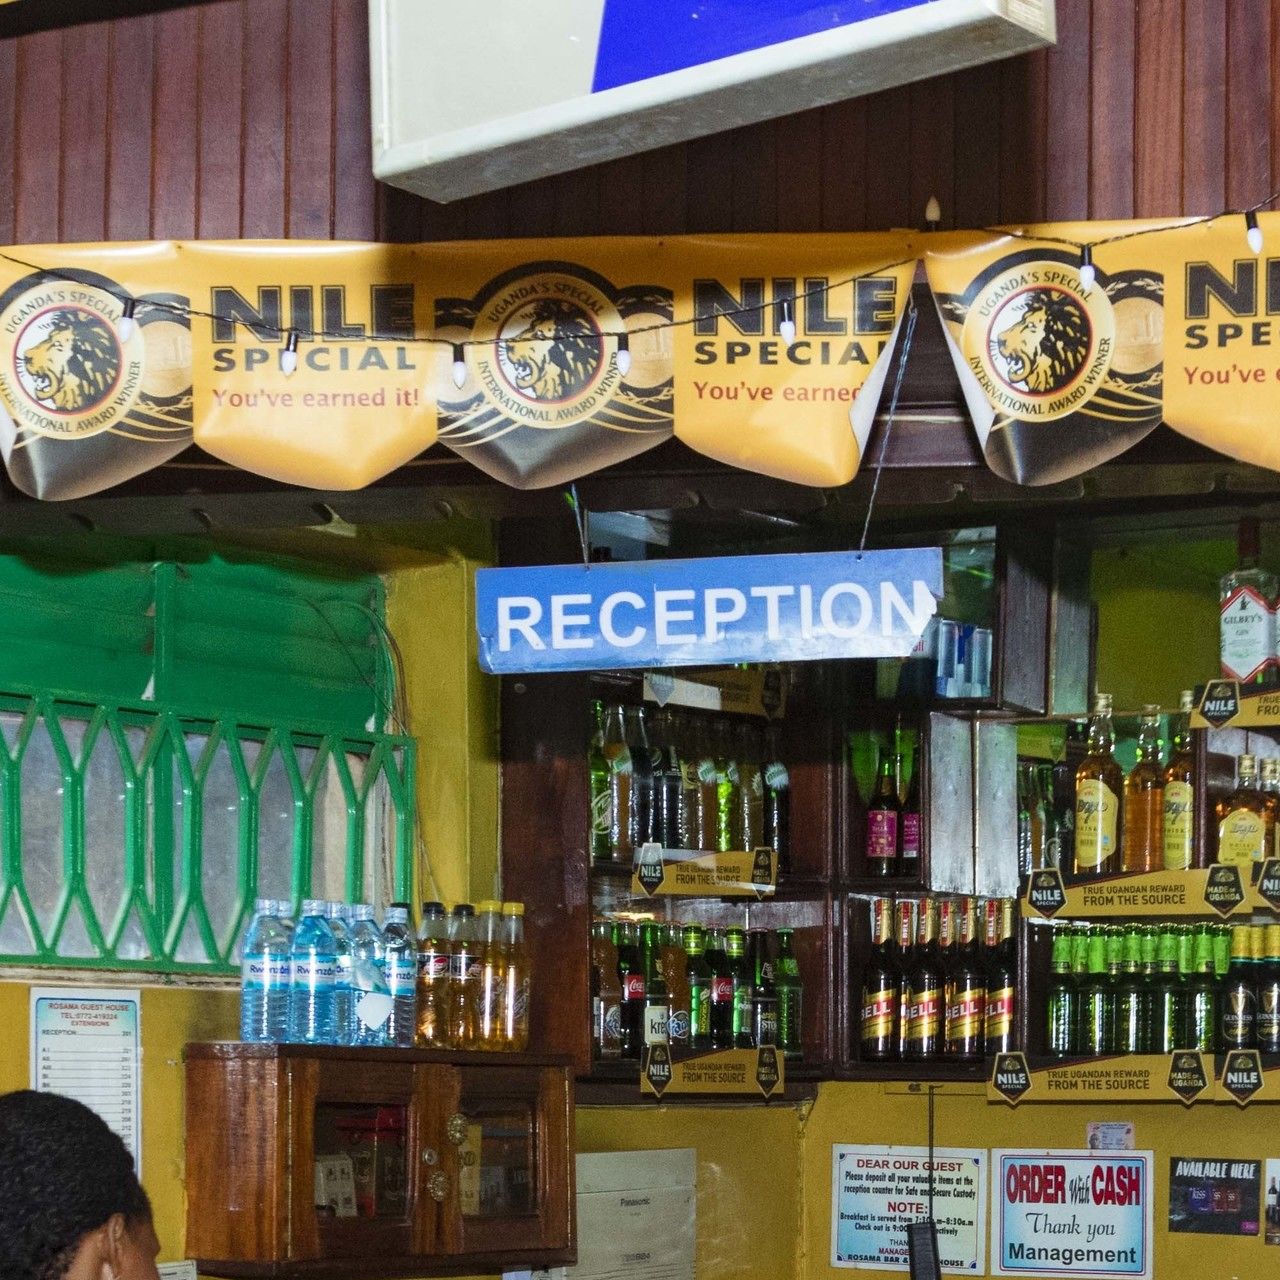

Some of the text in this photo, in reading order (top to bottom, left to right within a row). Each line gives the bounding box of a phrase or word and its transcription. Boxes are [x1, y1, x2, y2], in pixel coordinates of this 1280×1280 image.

[488, 280, 605, 323] UGANDA'S SPECIAL
[978, 270, 1095, 320] UGANDA'S SPECIAL
[4, 289, 124, 335] UGANDA'S SPECIAL
[211, 284, 414, 343] NILE
[692, 277, 899, 337] NILE
[214, 347, 416, 372] SPCIAL
[969, 337, 1111, 416] INTERNATIONAL AWARD WINNER
[1184, 363, 1266, 386] You've
[75, 403, 117, 434] AWARD
[114, 361, 142, 409] WINNER
[213, 387, 419, 407] You've earned it!
[476, 359, 553, 422] INTERNATIONAL
[555, 393, 598, 422] AWARD
[693, 381, 774, 402] You've
[497, 580, 936, 653] RECEPTION
[1031, 888, 1062, 902] NILE
[1082, 884, 1185, 895] TRUE UGANDAN REWARD
[1083, 893, 1186, 906] FROM THE SOURCE
[48, 1003, 128, 1012] ROSAMA GUEST HOUSE
[997, 1073, 1026, 1085] NILE
[1047, 1078, 1150, 1091] FROM THE SOURCE
[857, 1159, 963, 1172] DEAR OUR GUEST
[1175, 1161, 1257, 1179] AVAILABLE HERE
[845, 1171, 863, 1181] Please
[866, 1172, 885, 1183] deposit
[898, 1175, 910, 1184] your
[938, 1175, 953, 1185] items
[956, 1177, 962, 1185] at
[964, 1176, 973, 1185] the
[1006, 1163, 1140, 1206] ORDER With CASH
[844, 1184, 870, 1197] reception
[872, 1186, 892, 1194] counter
[895, 1186, 903, 1195] for
[906, 1186, 918, 1196] Safe
[932, 1188, 950, 1197] Secure
[953, 1188, 976, 1200] Custody
[840, 1212, 868, 1220] Breakfast
[878, 1214, 896, 1222] served
[899, 1215, 912, 1223] from
[888, 1202, 928, 1214] NOTE:
[855, 1223, 871, 1231] Check
[886, 1224, 890, 1232] is
[1026, 1212, 1116, 1243] Thank you
[848, 1254, 880, 1262] ROSAMA
[884, 1255, 900, 1263] BAR
[1009, 1243, 1136, 1265] Management
